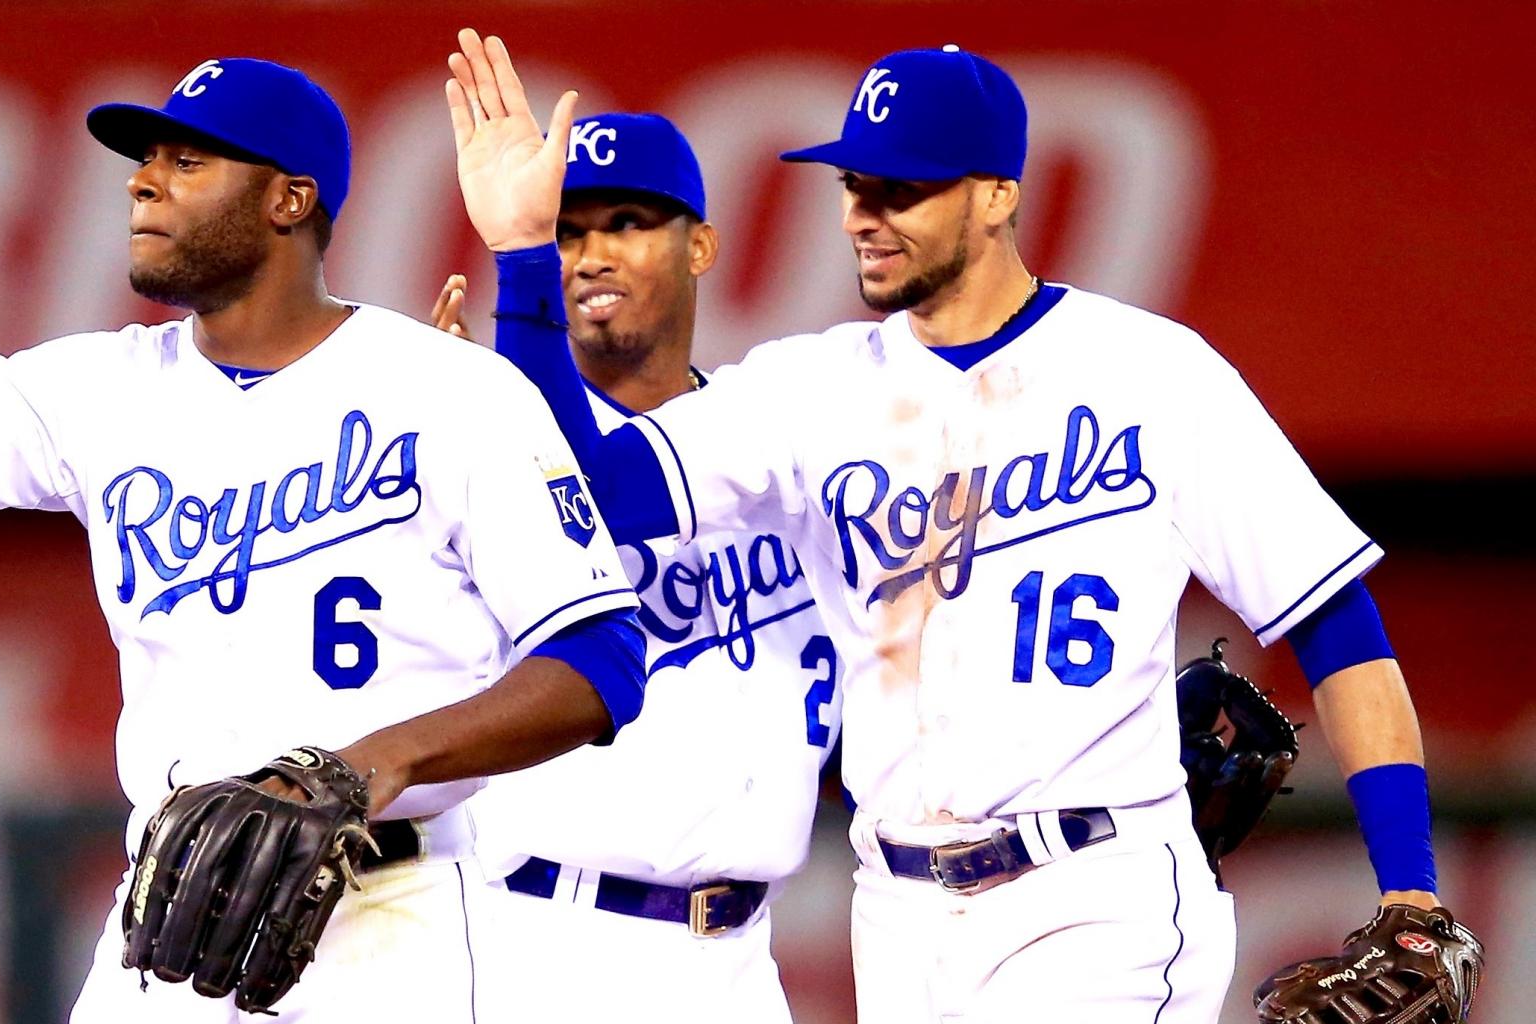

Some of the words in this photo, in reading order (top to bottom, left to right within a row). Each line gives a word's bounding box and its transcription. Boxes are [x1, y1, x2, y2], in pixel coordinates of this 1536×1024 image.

[566, 120, 617, 166] KC
[853, 68, 899, 123] KC
[102, 410, 421, 623] Royals
[550, 485, 595, 530] KC
[822, 404, 1156, 612] Royals
[313, 577, 382, 690] 6
[616, 533, 816, 672] Roya
[1011, 571, 1120, 687] 16
[800, 634, 837, 748] 2
